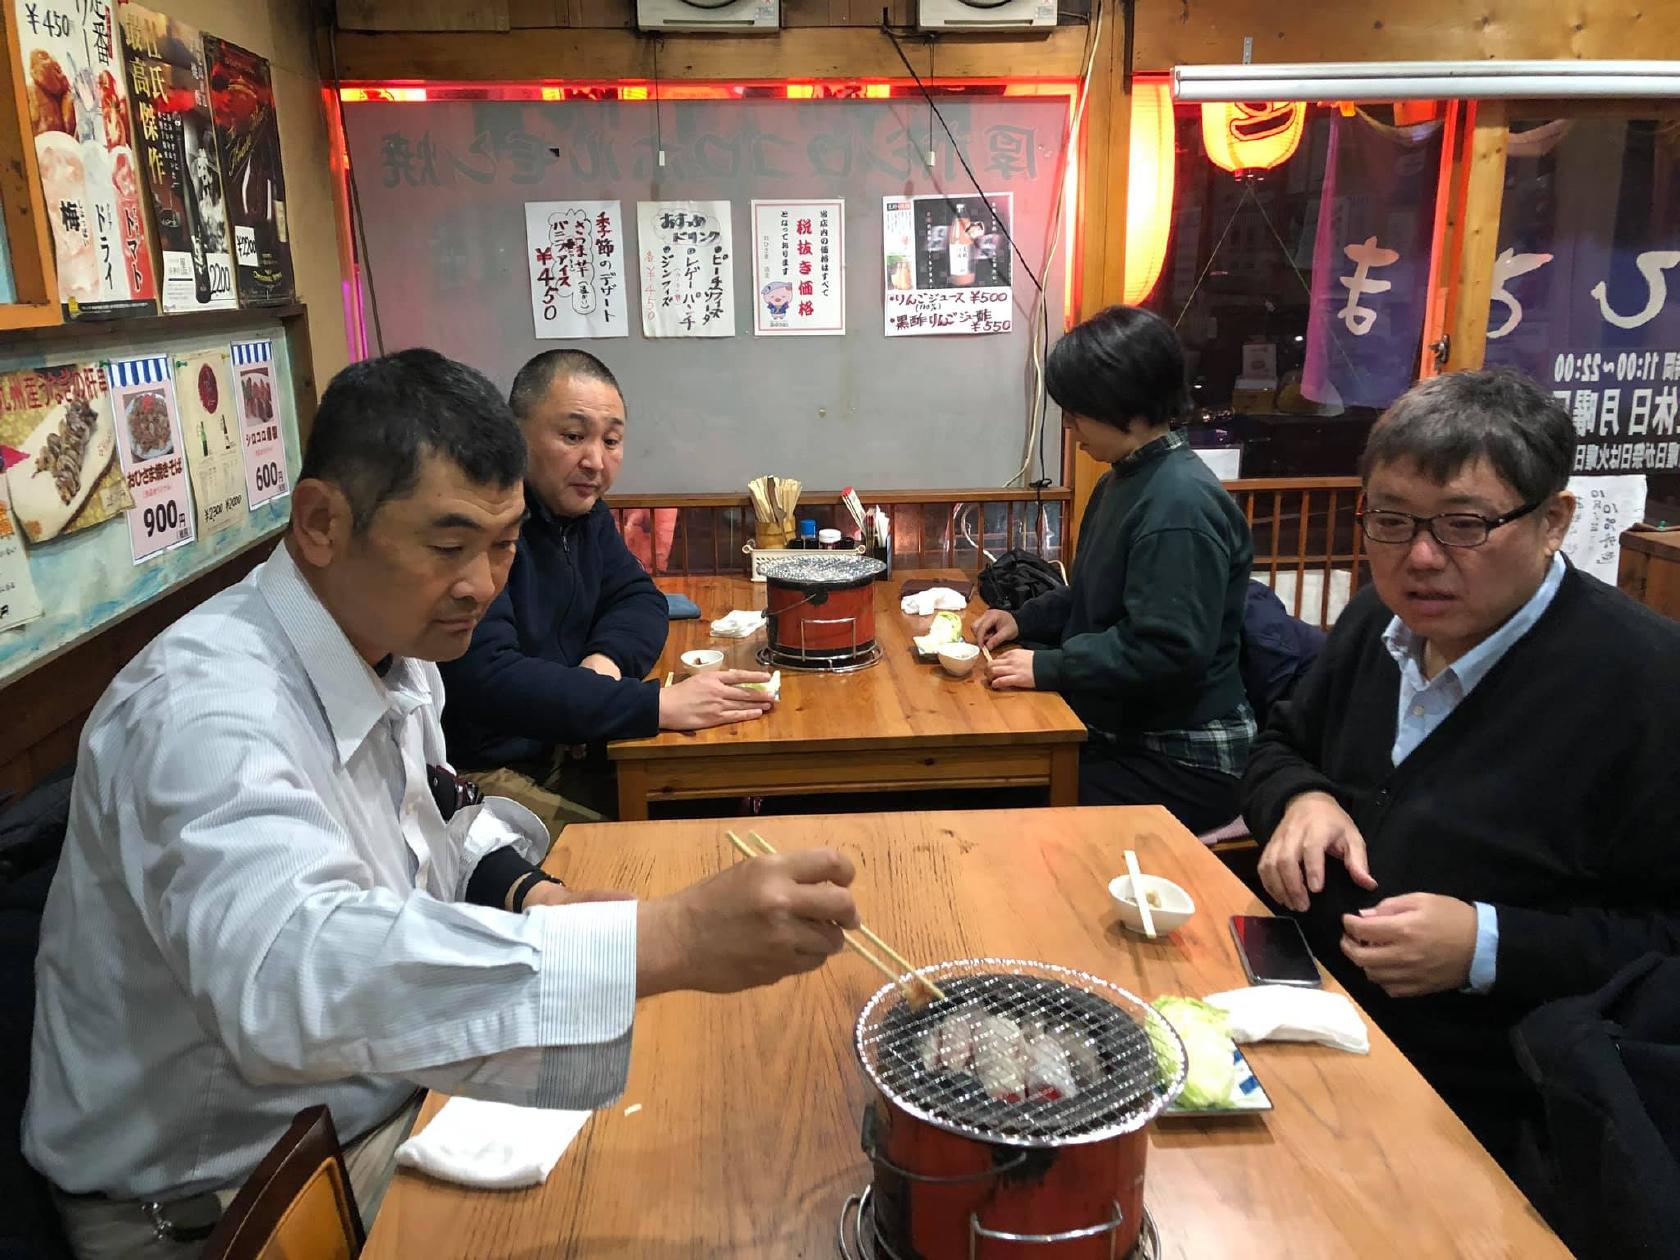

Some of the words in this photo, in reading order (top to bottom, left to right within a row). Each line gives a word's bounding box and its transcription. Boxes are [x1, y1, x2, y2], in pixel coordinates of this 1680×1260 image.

[25, 3, 70, 37] ¥450
[60, 200, 80, 232] 梅
[95, 203, 113, 290] ドライ
[673, 231, 721, 243] ドリンク
[780, 211, 789, 276] となっております
[125, 208, 144, 291] トマト
[595, 211, 617, 322] 季節のデザート
[796, 218, 815, 317] 税抜き価格
[820, 209, 829, 297] 当店内の価格はすべて
[535, 247, 559, 321] ¥450
[970, 291, 1008, 304] ¥500
[971, 320, 1011, 332] ¥550
[127, 457, 182, 488] おひさま焼きそば
